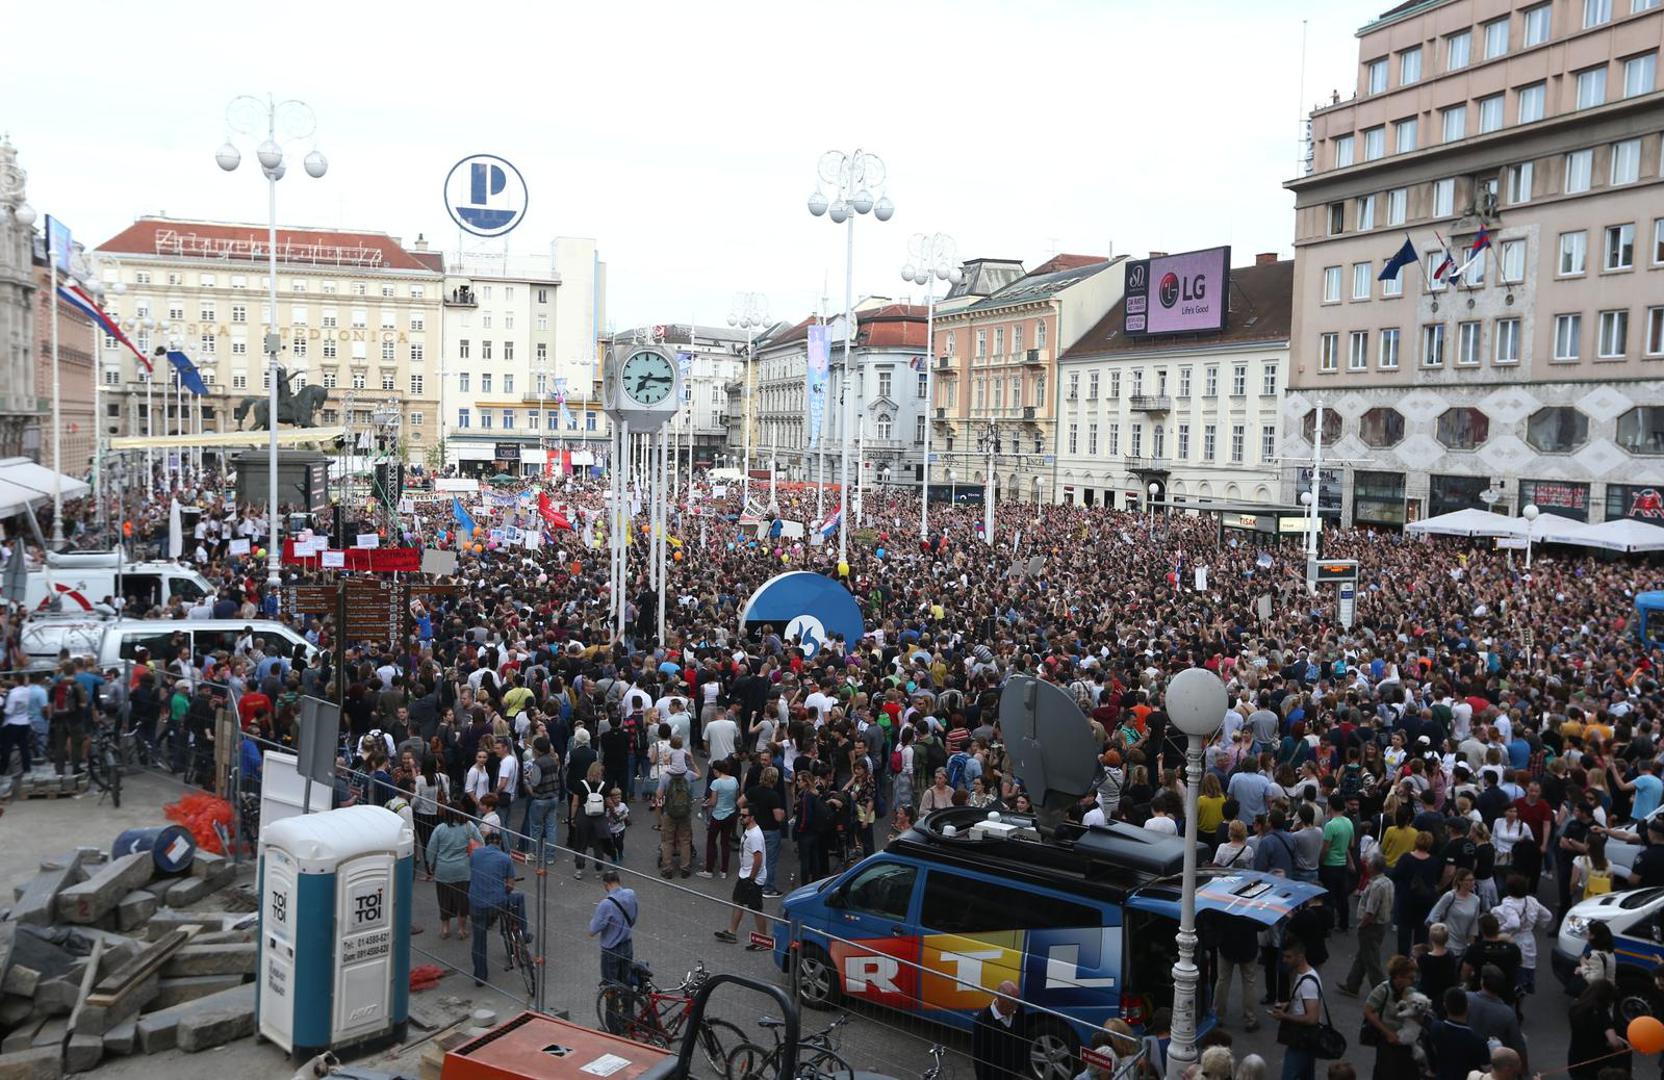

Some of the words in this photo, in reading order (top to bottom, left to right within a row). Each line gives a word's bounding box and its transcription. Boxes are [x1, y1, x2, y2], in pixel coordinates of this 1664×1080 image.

[1182, 274, 1206, 301] LG
[1195, 305, 1209, 314] Good
[1240, 518, 1257, 527] TISAK
[355, 888, 383, 909] TOI
[355, 906, 382, 923] TOI
[844, 943, 1115, 993] RTL
